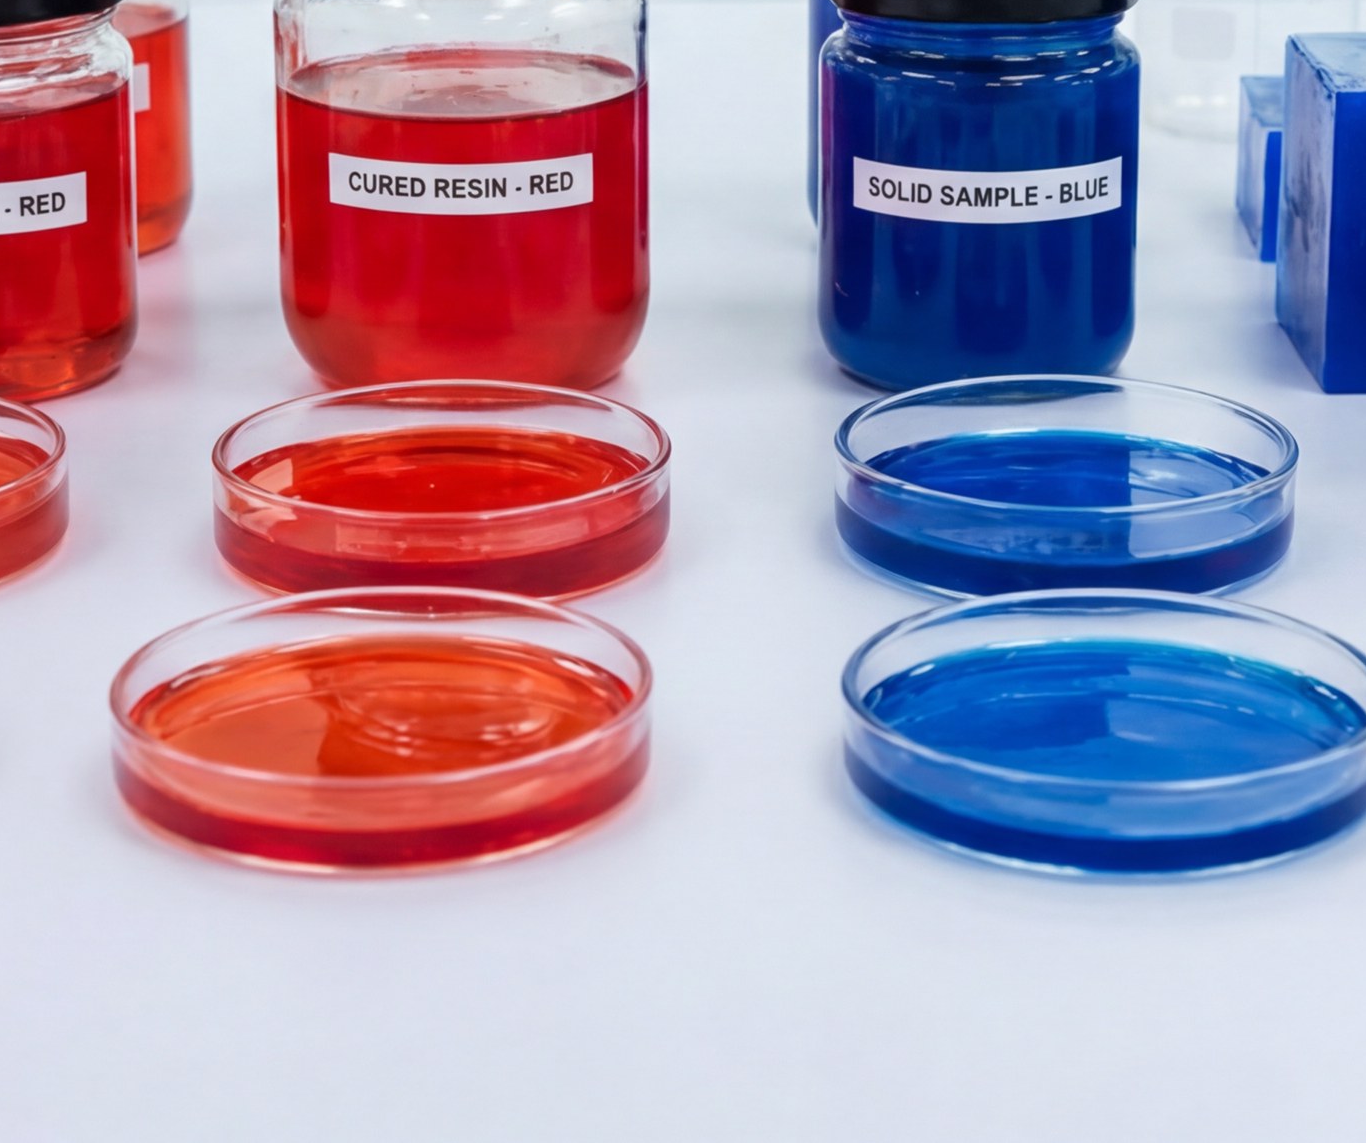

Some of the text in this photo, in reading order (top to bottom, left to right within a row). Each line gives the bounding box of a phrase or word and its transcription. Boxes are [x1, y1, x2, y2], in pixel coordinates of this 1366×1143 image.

[348, 171, 426, 198] CURED
[434, 177, 507, 199] RESIN
[530, 171, 574, 195] RED
[868, 175, 932, 204] SOLID
[940, 185, 1038, 208] SAMPLE
[1059, 175, 1109, 204] BLUE
[19, 191, 66, 217] RED
